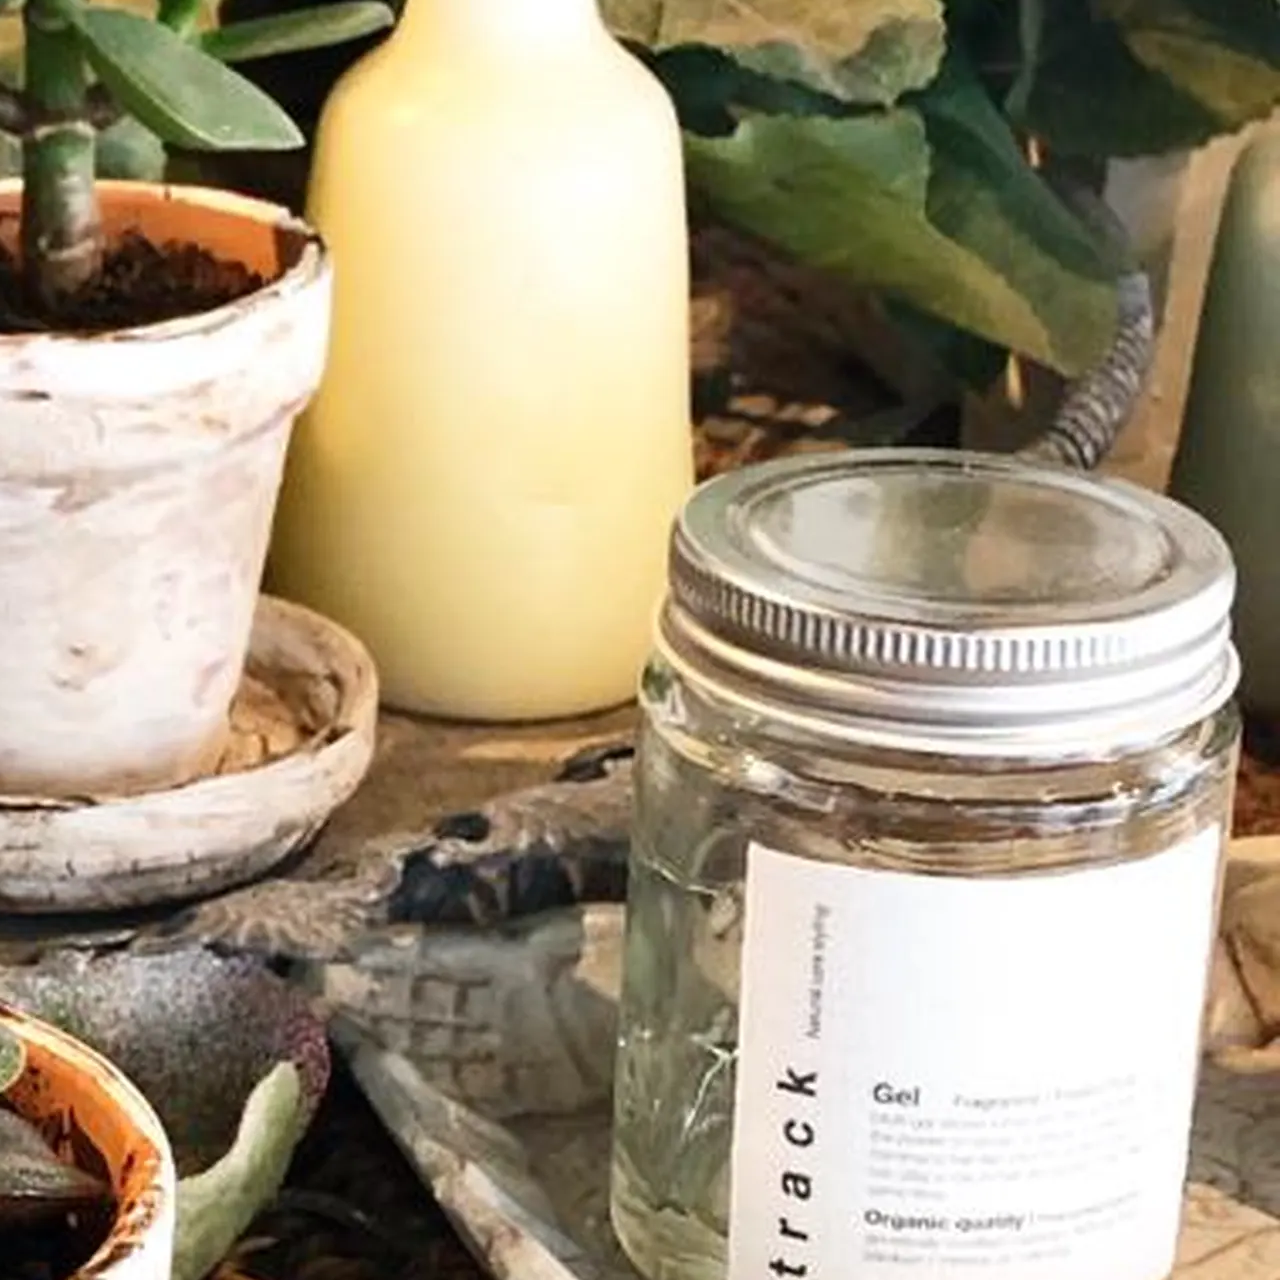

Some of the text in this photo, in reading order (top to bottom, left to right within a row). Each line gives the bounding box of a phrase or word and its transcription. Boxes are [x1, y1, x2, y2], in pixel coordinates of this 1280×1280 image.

[872, 1081, 921, 1107] Gel
[768, 1067, 819, 1278] track
[863, 1208, 948, 1233] Organic
